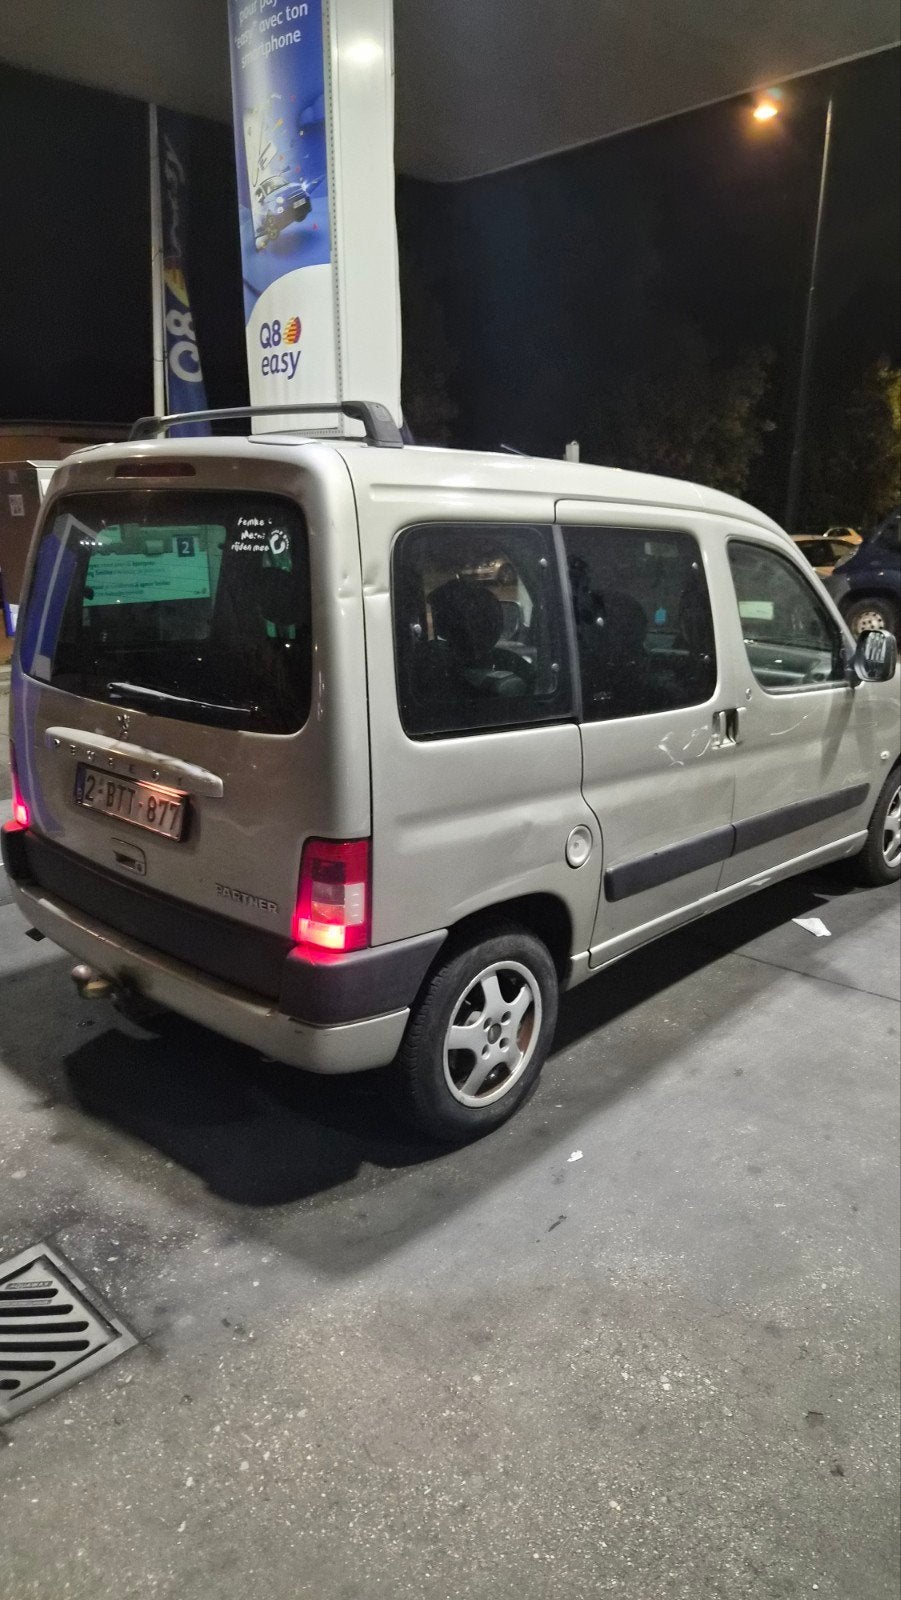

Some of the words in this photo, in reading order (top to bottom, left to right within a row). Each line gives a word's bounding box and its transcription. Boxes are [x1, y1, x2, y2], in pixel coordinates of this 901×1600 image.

[259, 11, 283, 32] avec
[286, 3, 308, 21] ton
[260, 319, 282, 349] Q8
[261, 350, 301, 380] easy
[181, 541, 190, 554] 2
[84, 775, 181, 831] 2-BTT-877
[215, 882, 279, 913] PARTNER
